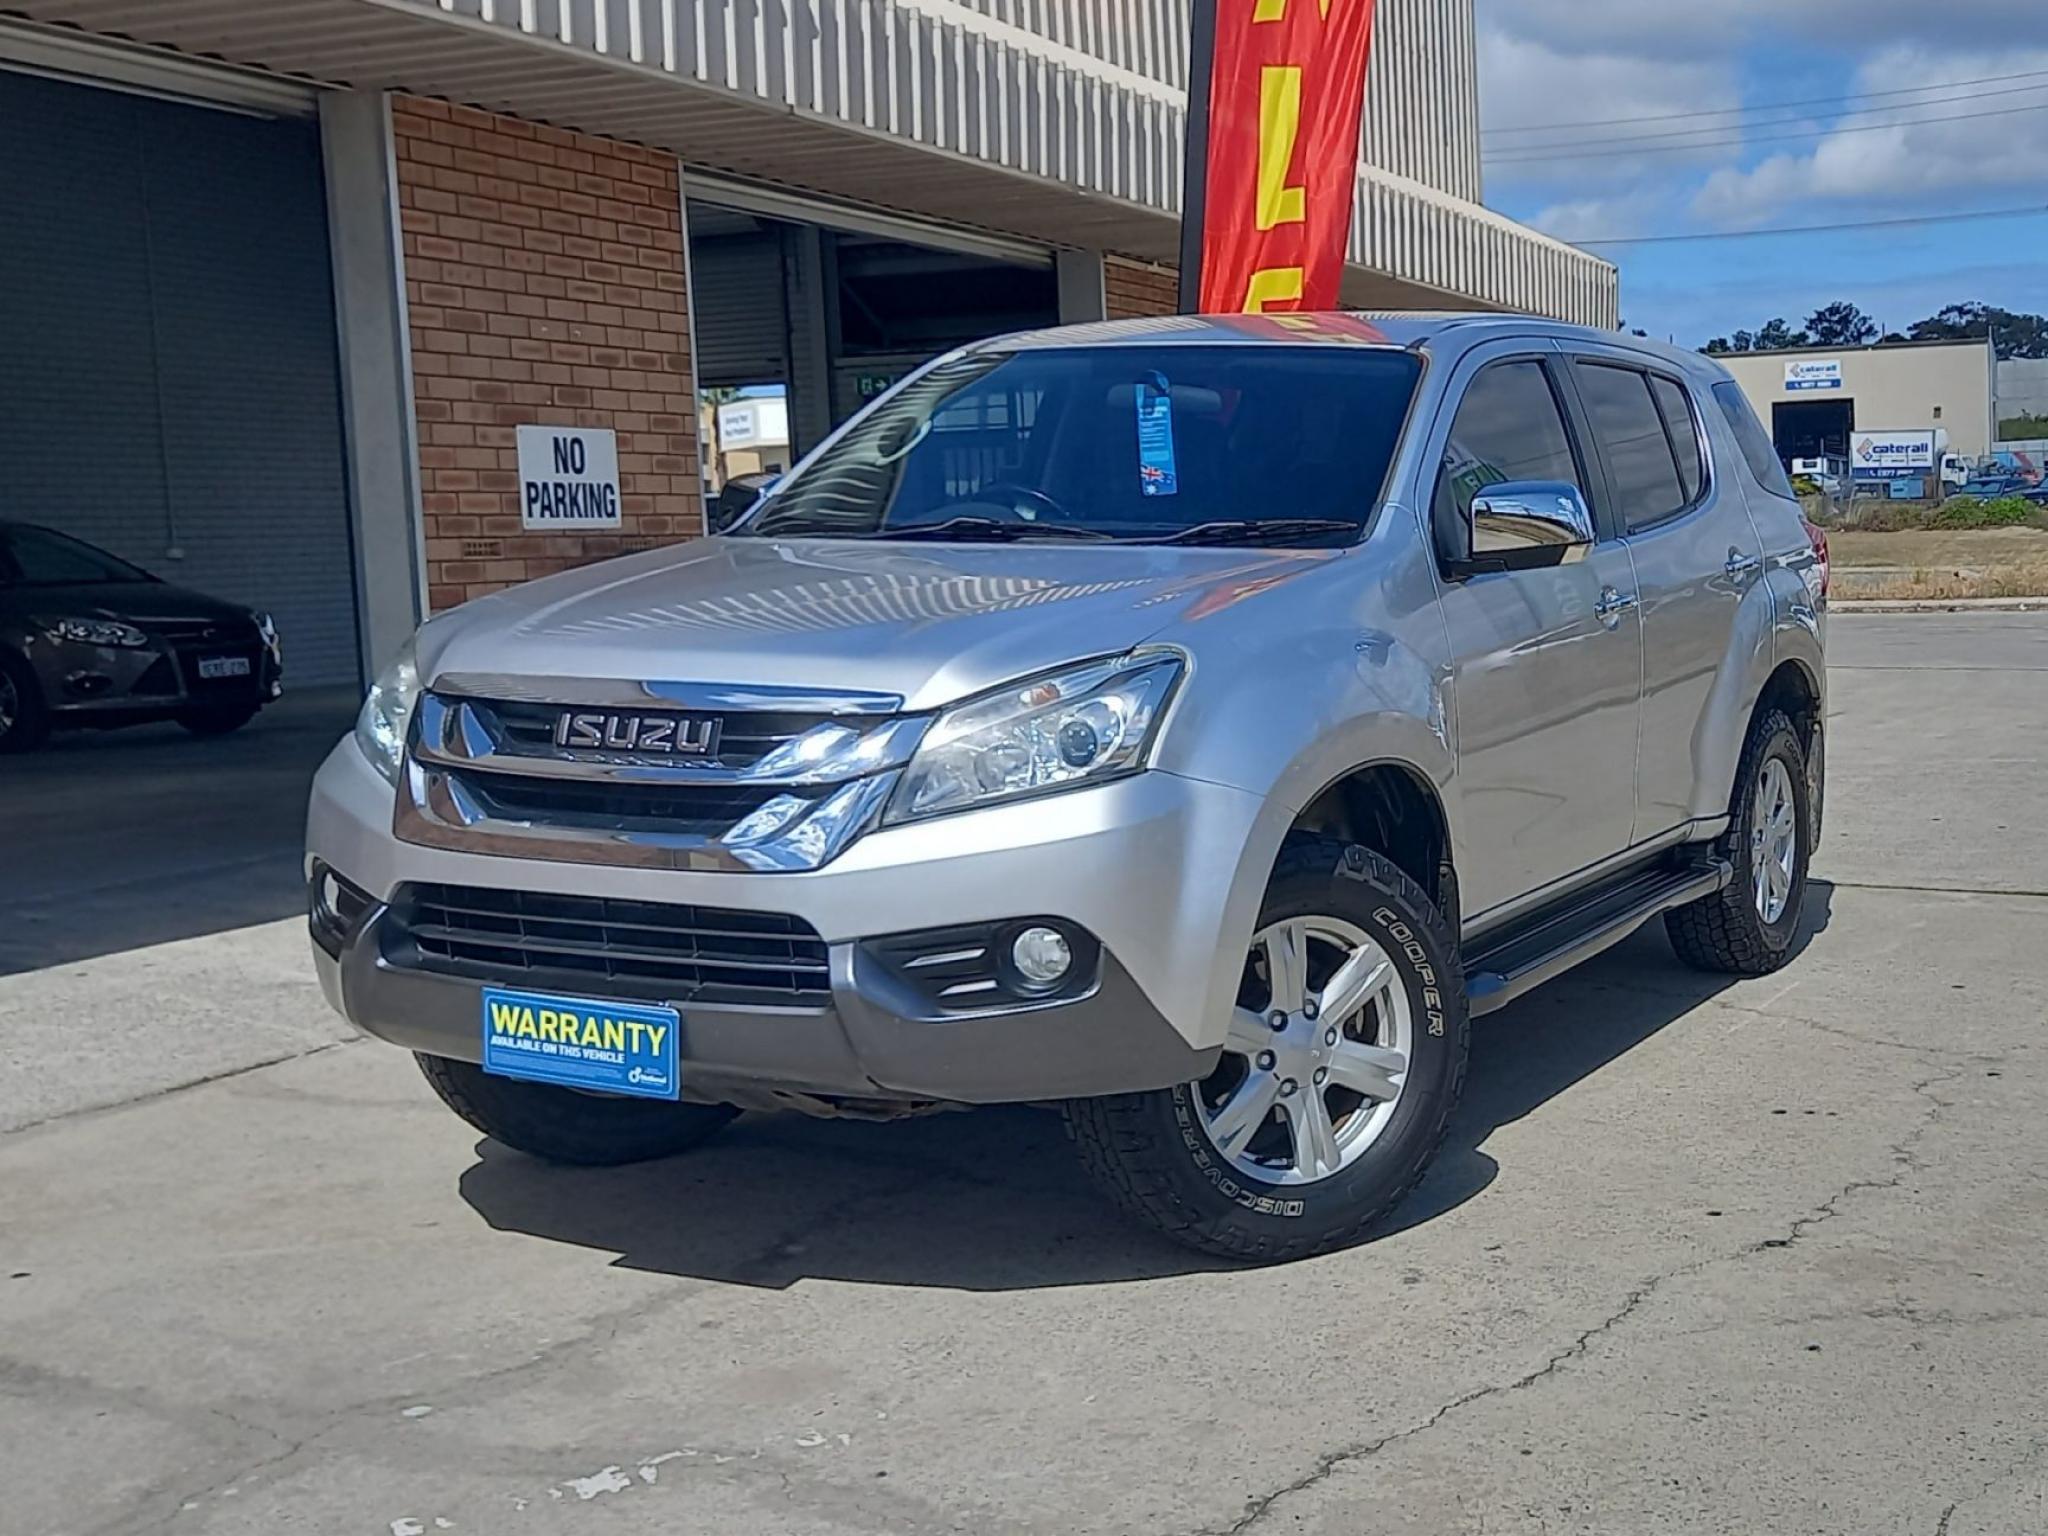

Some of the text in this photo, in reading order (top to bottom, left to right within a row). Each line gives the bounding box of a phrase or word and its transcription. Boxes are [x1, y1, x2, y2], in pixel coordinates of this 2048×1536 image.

[552, 436, 586, 475] NO
[1872, 442, 1928, 454] caterall
[525, 481, 617, 519] PARKING
[556, 713, 712, 753] ISUZU
[1372, 907, 1444, 1037] COOPER
[490, 1003, 667, 1057] WARRANTY
[490, 1035, 625, 1064] AVAILABLE ON THIS VEHICLE
